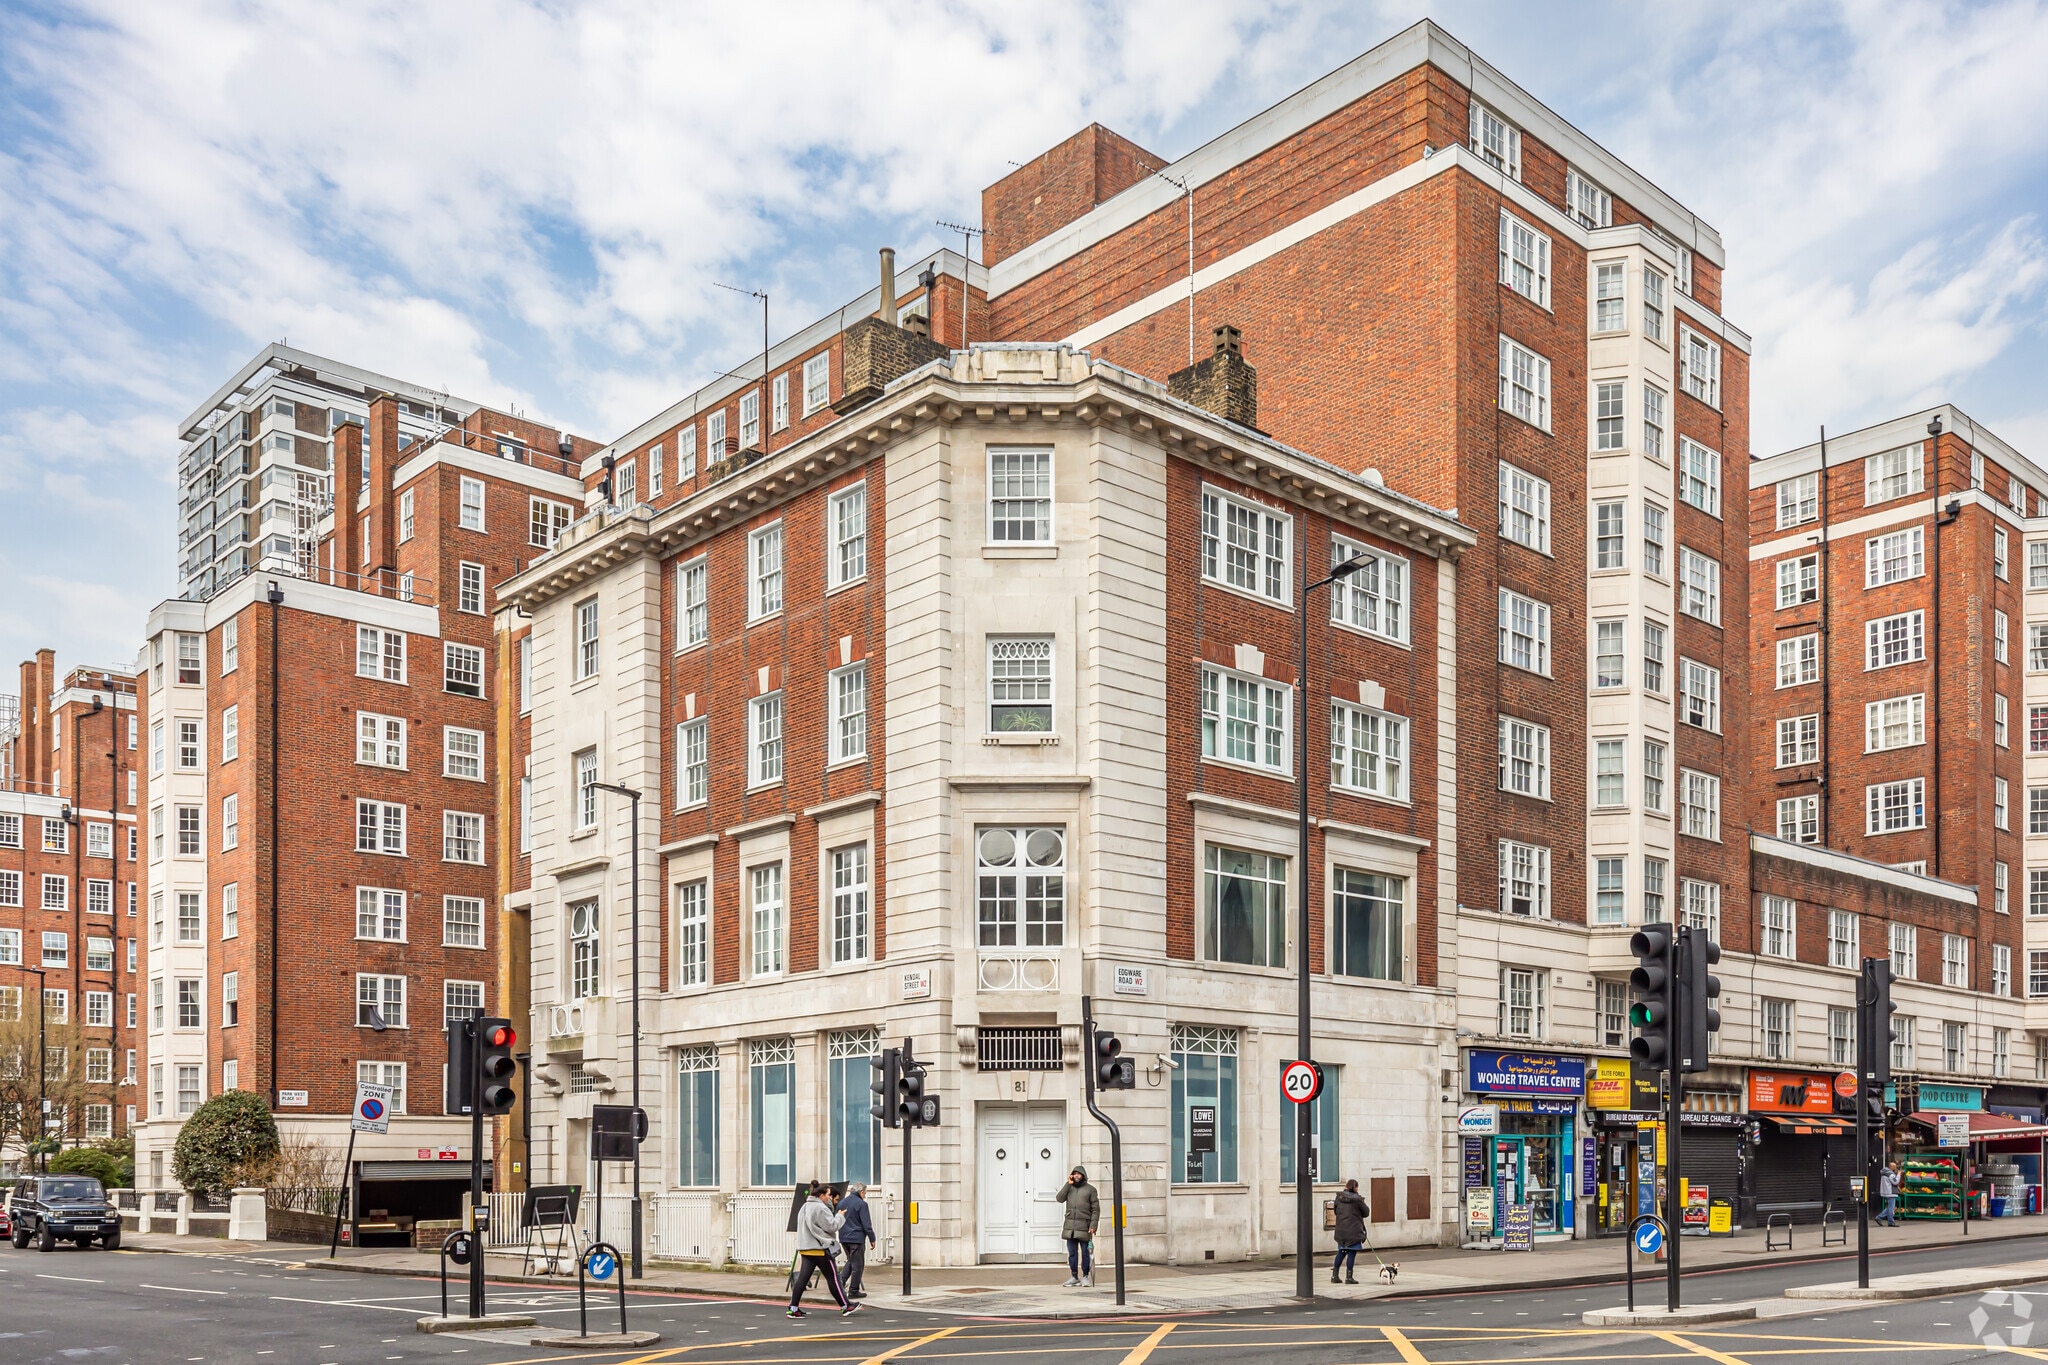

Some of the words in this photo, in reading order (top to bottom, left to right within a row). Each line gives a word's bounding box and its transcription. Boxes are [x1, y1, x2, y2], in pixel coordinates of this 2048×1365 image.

[904, 973, 920, 981] KENDAL
[1118, 968, 1142, 977] EDGWARE
[904, 981, 919, 990] STREET
[1118, 977, 1132, 985] ROAD
[1287, 1074, 1312, 1091] 20
[1478, 1072, 1516, 1085] WONDER
[1518, 1074, 1549, 1087] TRAVEL
[1550, 1076, 1580, 1088] CENTRE
[360, 1084, 392, 1092] Controlled
[1015, 1081, 1026, 1092] 81
[1591, 1081, 1623, 1091] DHL
[363, 1090, 386, 1099] ZONE
[1940, 1091, 1969, 1103] CENTRE
[1511, 1101, 1534, 1112] TRAVEL
[1194, 1111, 1212, 1121] LOWE
[1622, 1113, 1628, 1121] DE
[1628, 1113, 1644, 1121] CHANGE
[1680, 1113, 1700, 1121] BUREAU
[1701, 1114, 1709, 1122] DE
[1710, 1115, 1732, 1123] CHANGE
